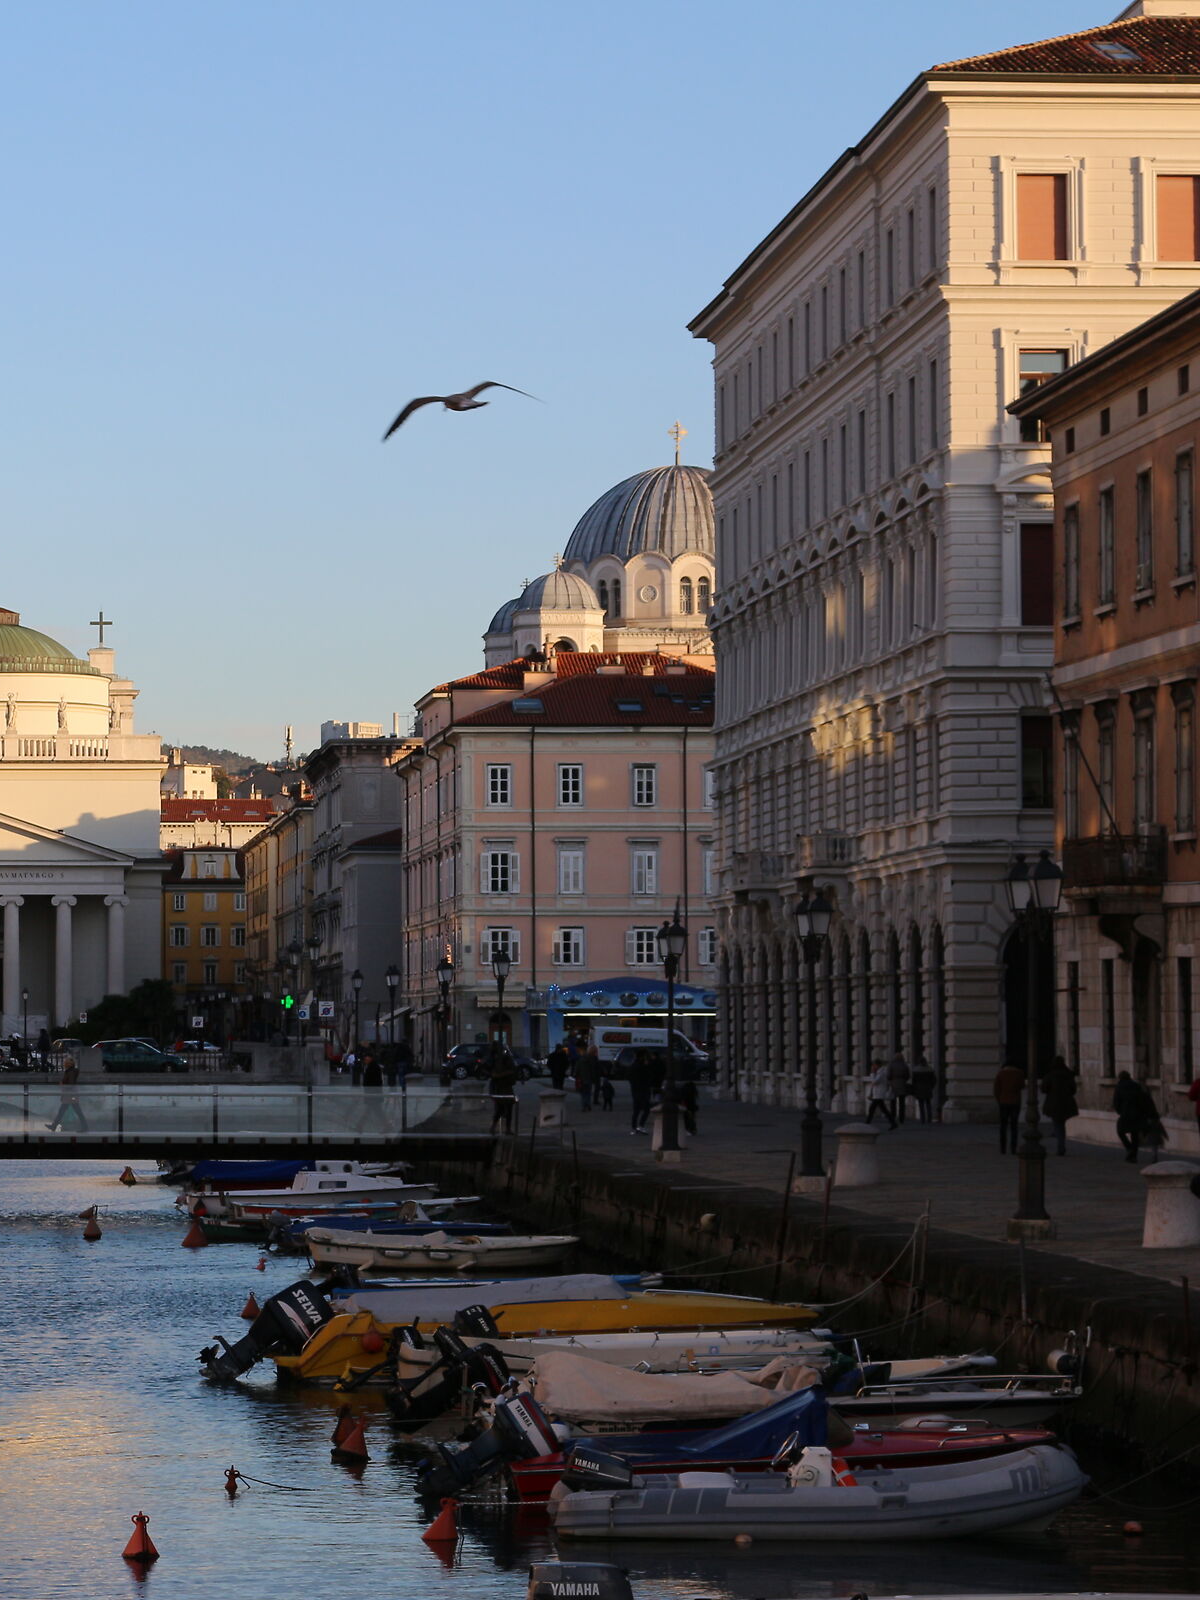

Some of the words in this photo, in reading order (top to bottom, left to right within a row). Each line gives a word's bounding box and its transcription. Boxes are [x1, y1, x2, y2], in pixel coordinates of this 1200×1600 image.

[291, 1288, 323, 1325] SELVA
[515, 1405, 533, 1428] YAMAHA
[574, 1457, 600, 1472] YAMAHA
[551, 1583, 600, 1596] YAMAHA
